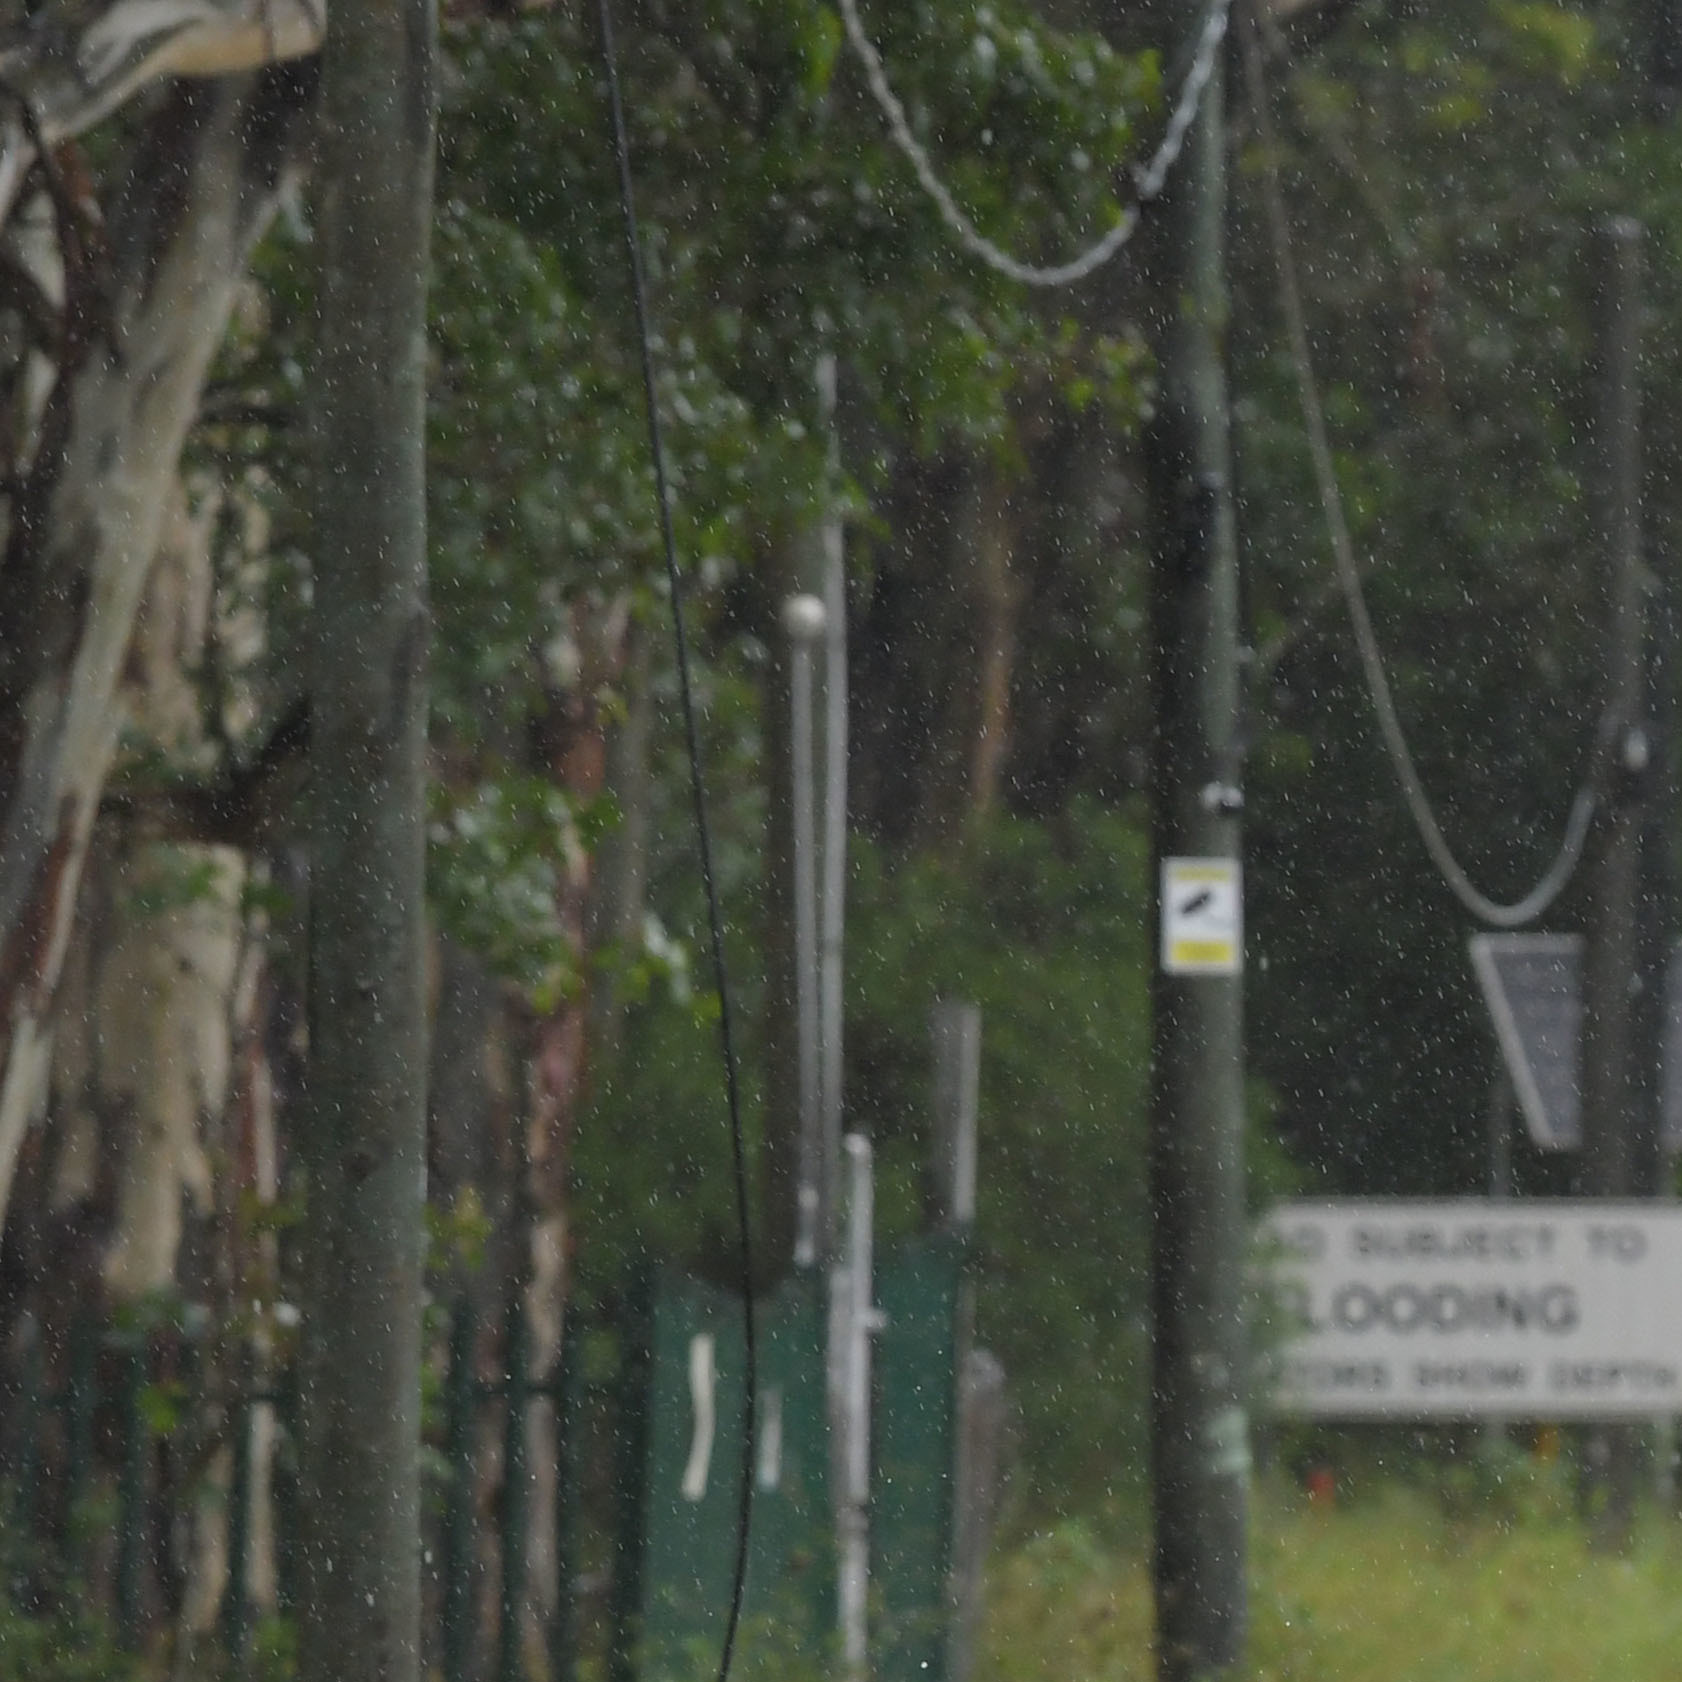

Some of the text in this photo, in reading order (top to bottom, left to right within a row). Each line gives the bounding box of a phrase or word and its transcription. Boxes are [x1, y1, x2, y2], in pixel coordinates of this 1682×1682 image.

[1348, 1222, 1557, 1264] SUBJECT
[1586, 1222, 1649, 1265] TO
[1299, 1283, 1580, 1336] LOODING
